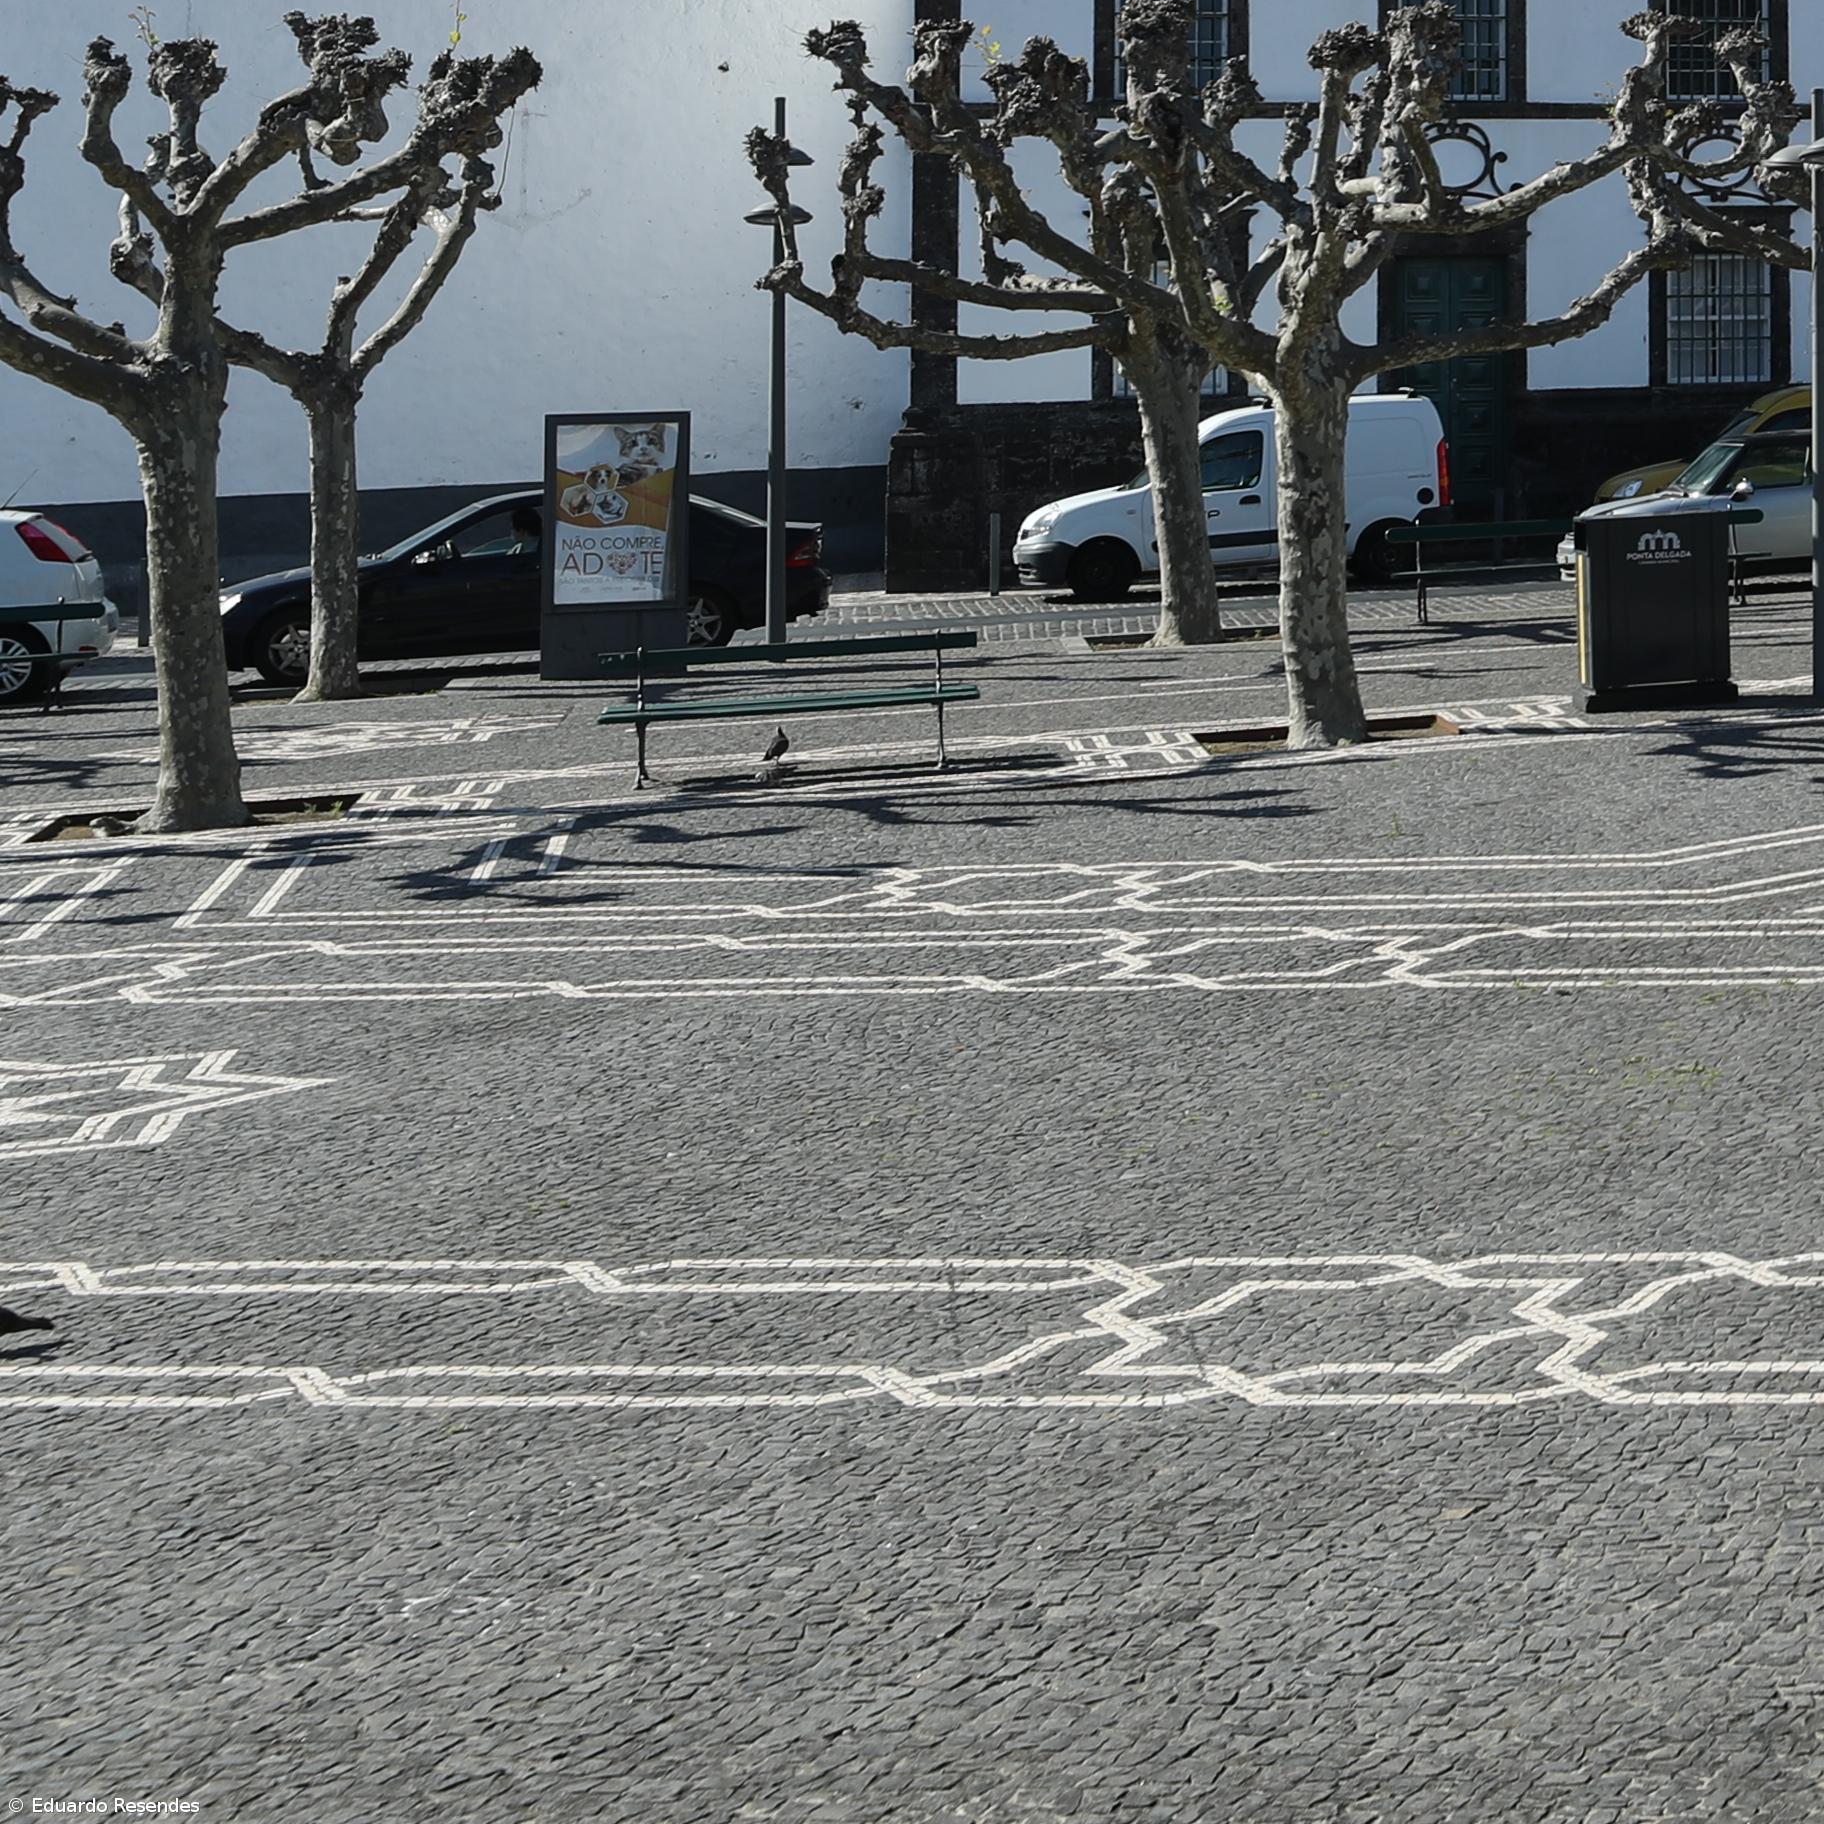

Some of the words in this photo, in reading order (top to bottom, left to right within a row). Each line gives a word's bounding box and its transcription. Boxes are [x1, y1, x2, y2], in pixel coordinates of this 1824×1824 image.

[562, 536, 596, 550] NÃO
[601, 537, 664, 550] COMPRE,
[1626, 552, 1653, 560] PONTA
[1654, 550, 1692, 559] DELGADA
